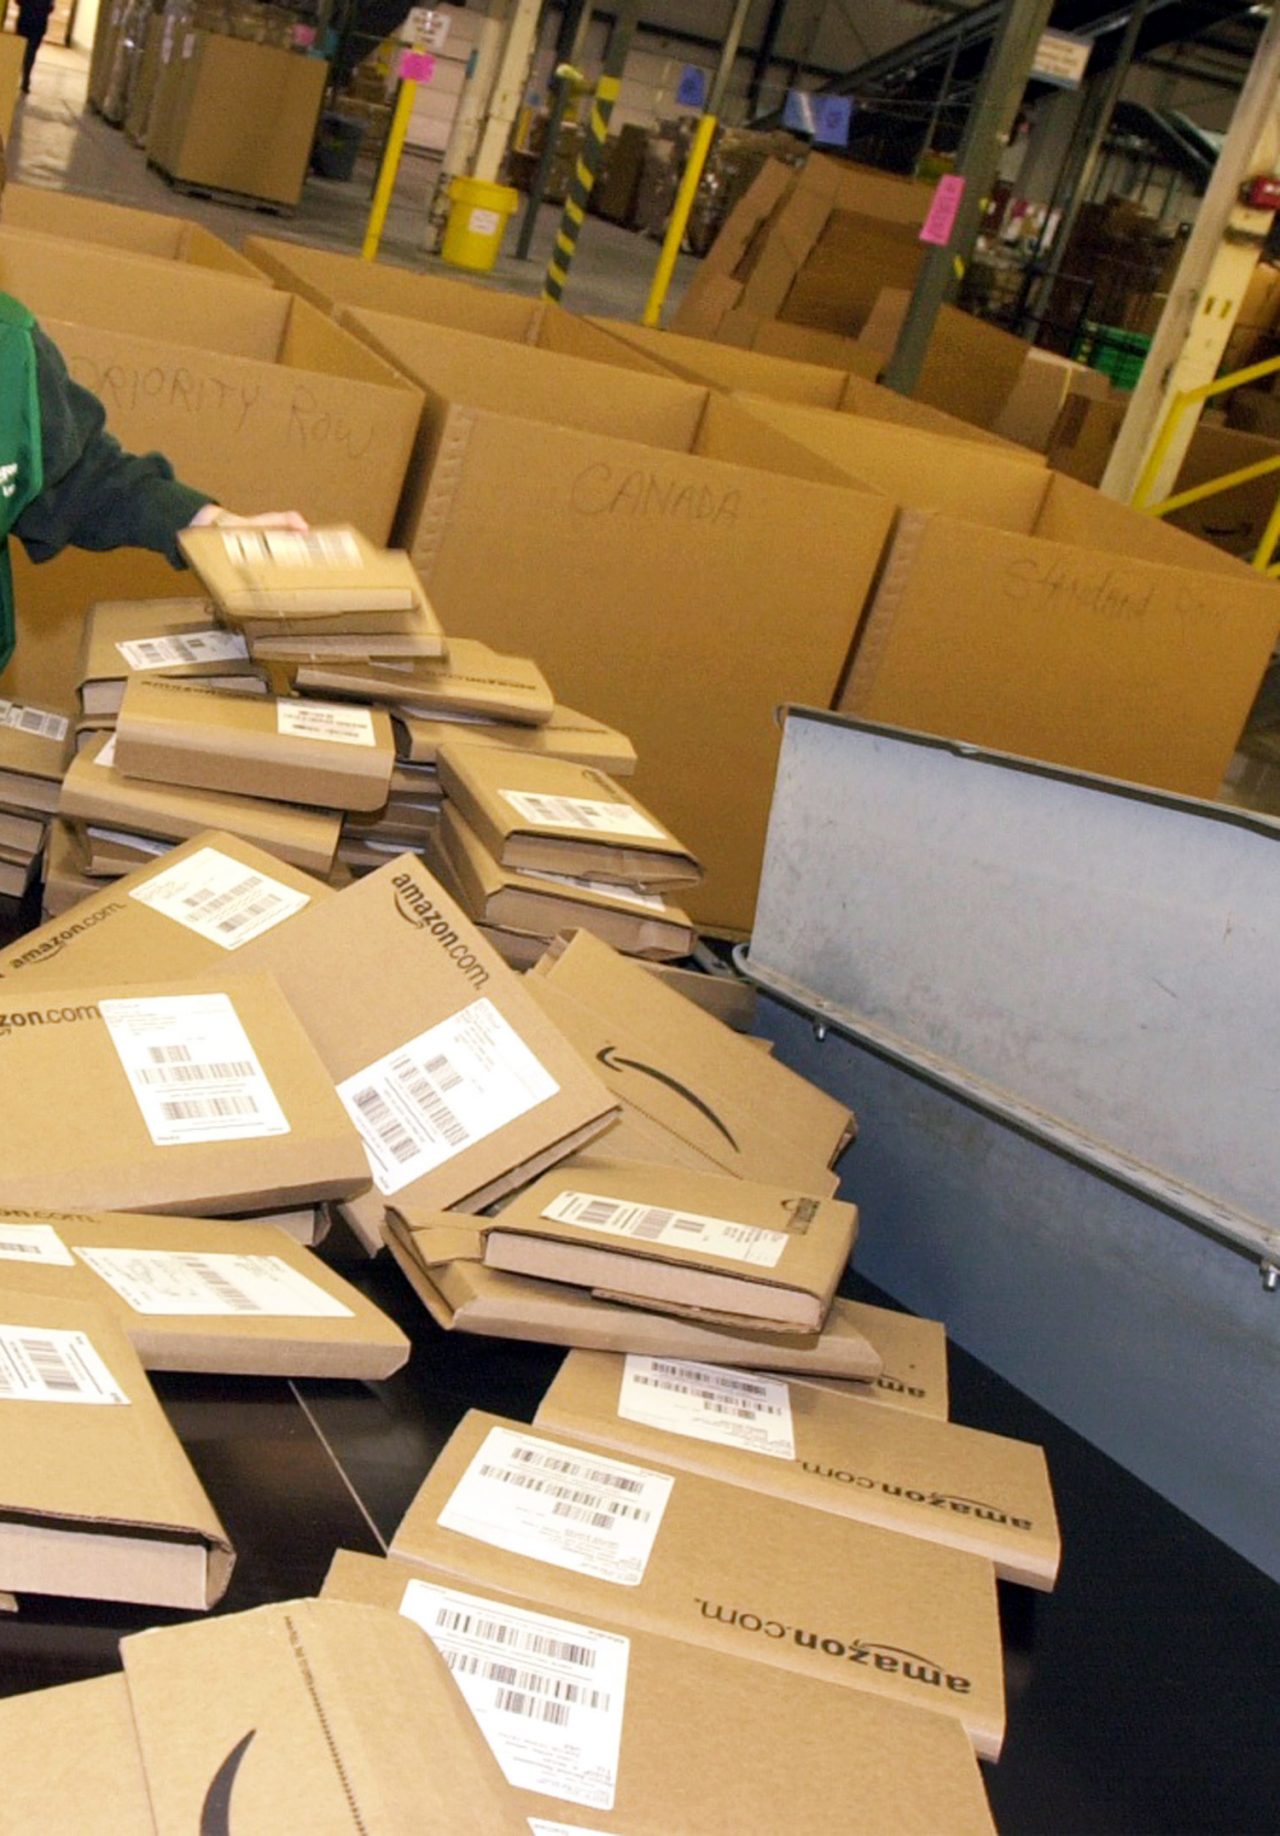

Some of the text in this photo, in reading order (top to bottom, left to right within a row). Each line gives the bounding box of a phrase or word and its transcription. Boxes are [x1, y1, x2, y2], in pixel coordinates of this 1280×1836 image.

[572, 462, 742, 523] CANADA
[11, 901, 126, 968] amazon.com
[391, 873, 489, 990] amazon.com
[798, 1460, 1032, 1530] amazon.com
[695, 1598, 971, 1694] amazon.com
